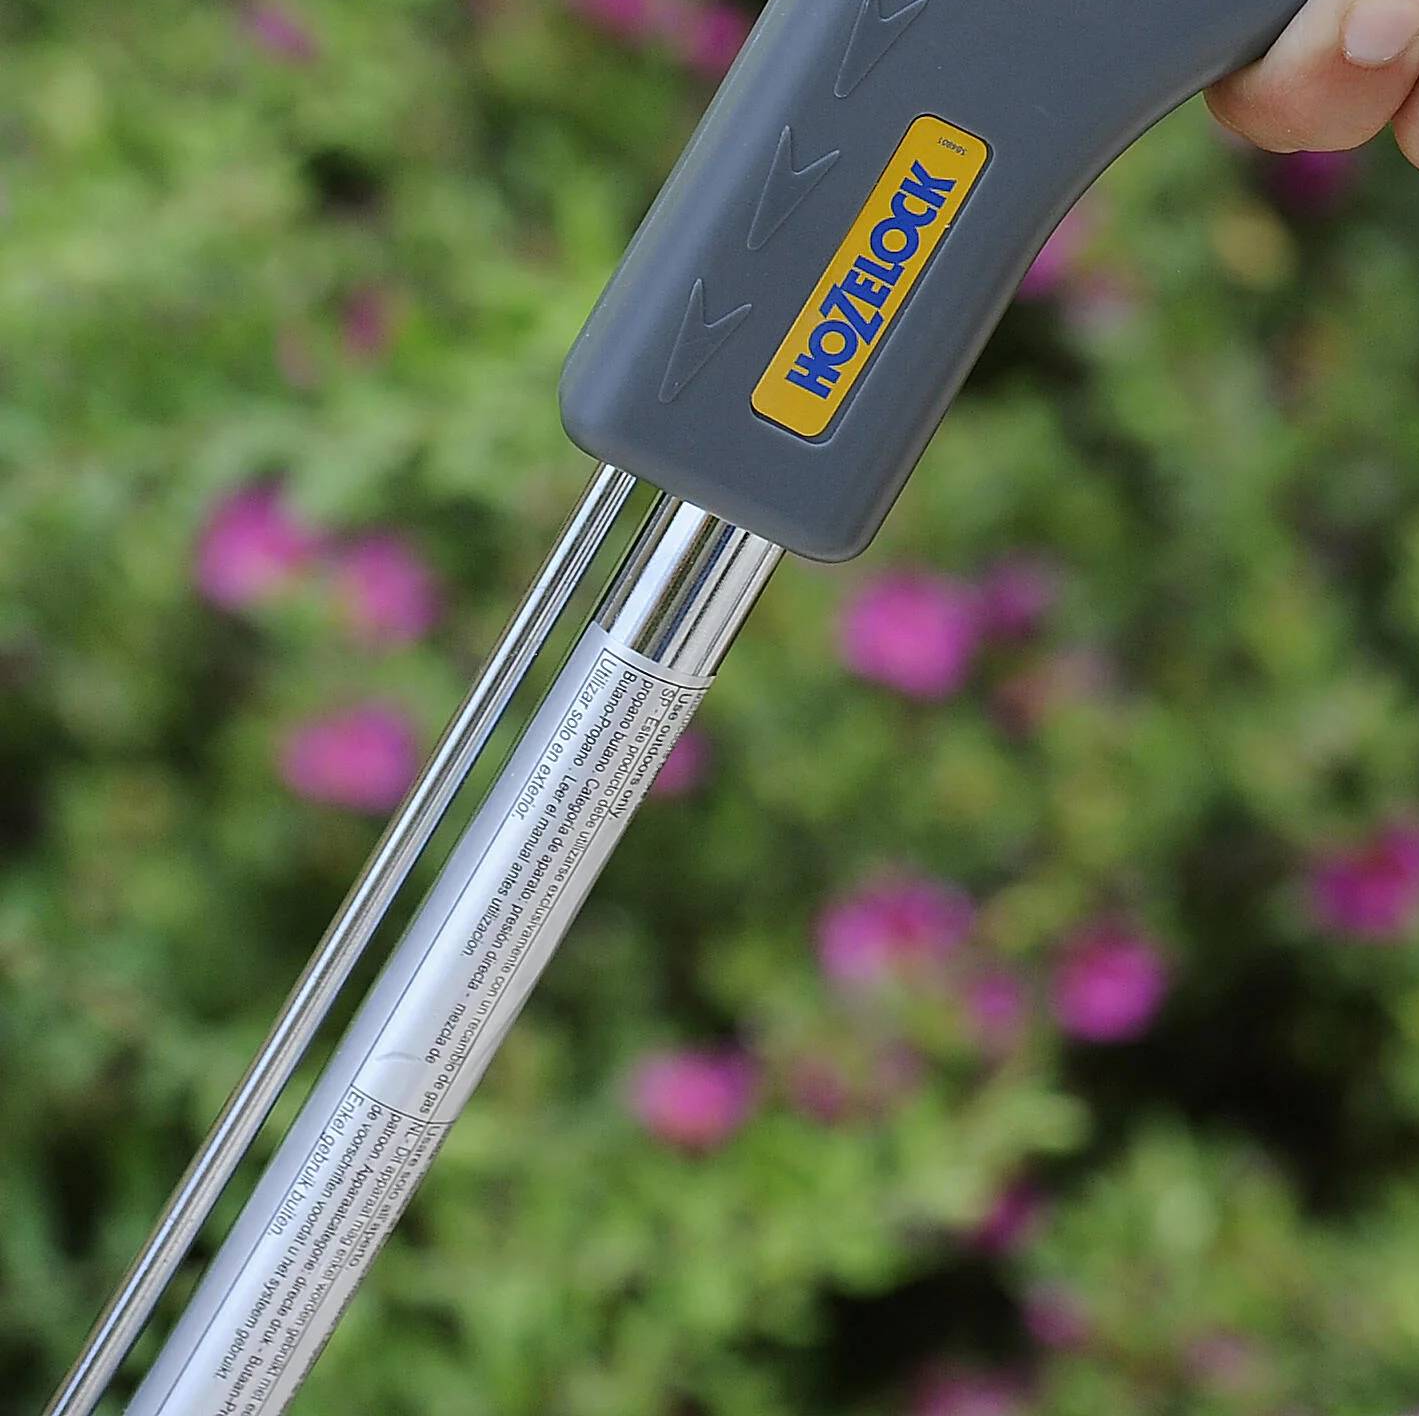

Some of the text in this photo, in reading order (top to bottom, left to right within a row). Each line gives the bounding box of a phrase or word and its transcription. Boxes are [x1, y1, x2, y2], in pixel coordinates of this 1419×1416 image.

[785, 160, 956, 400] HOZELOCK
[569, 667, 637, 770] Butano-Propano
[616, 678, 653, 730] propano
[655, 686, 674, 708] SP
[510, 656, 617, 823] Utilizar solo en exterior.
[634, 715, 657, 745] Este
[591, 729, 626, 778] butano.
[601, 743, 640, 799] producto
[605, 690, 691, 824] Use outdoors only.
[543, 802, 559, 818] el
[550, 773, 576, 805] Leer
[584, 797, 610, 830] debe
[516, 815, 551, 863] manual
[547, 835, 565, 855] de
[552, 829, 591, 884] utilizarse
[496, 860, 524, 897] antes
[499, 882, 560, 976] exclusivamente
[466, 948, 499, 992] directa
[486, 973, 506, 999] con
[434, 1001, 468, 1048] mezcla
[475, 998, 491, 1016] un
[423, 1046, 442, 1066] de
[442, 1015, 484, 1075] recambio
[416, 1088, 439, 1116] gas
[432, 1072, 452, 1093] de
[365, 1103, 384, 1123] de
[365, 1111, 403, 1165] patroon.
[389, 1144, 410, 1167] Dit
[407, 1122, 440, 1169] Usare
[266, 1089, 365, 1241] Enkel gebruik buiten.
[320, 1120, 375, 1201] voorschriften
[357, 1163, 397, 1219] apparaat
[387, 1168, 413, 1202] solo
[293, 1198, 329, 1247] voordat
[339, 1216, 365, 1248] mag
[274, 1255, 297, 1280] het
[287, 1245, 300, 1256] u
[321, 1246, 349, 1283] enkel
[240, 1274, 283, 1331] systeem
[277, 1275, 309, 1319] directe
[294, 1280, 329, 1329] worden
[259, 1317, 284, 1348] druk
[264, 1326, 302, 1379] gebruikt
[250, 1375, 272, 1403] met
